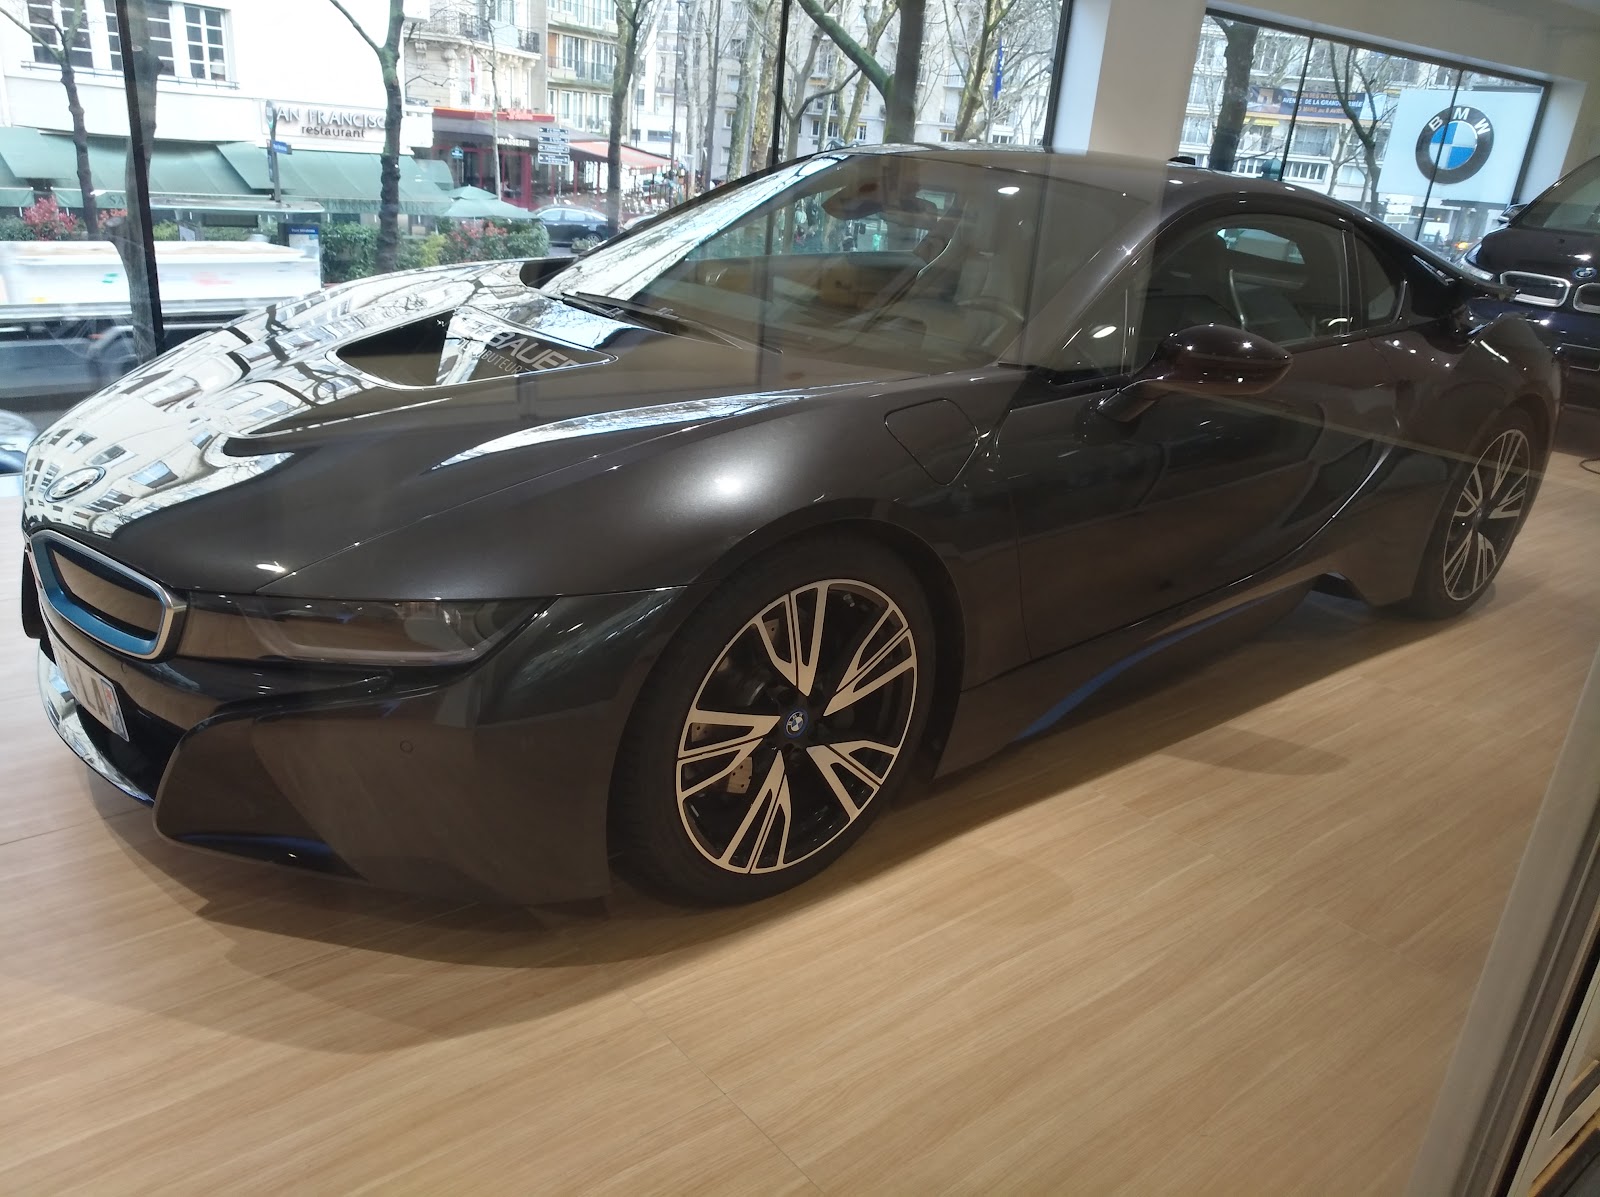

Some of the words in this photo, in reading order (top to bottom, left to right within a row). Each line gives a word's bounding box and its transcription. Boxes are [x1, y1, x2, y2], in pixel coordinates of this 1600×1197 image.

[276, 106, 300, 123] AN
[308, 108, 386, 129] FRANCISC
[1429, 107, 1490, 135] BMW
[301, 124, 366, 138] restaurant
